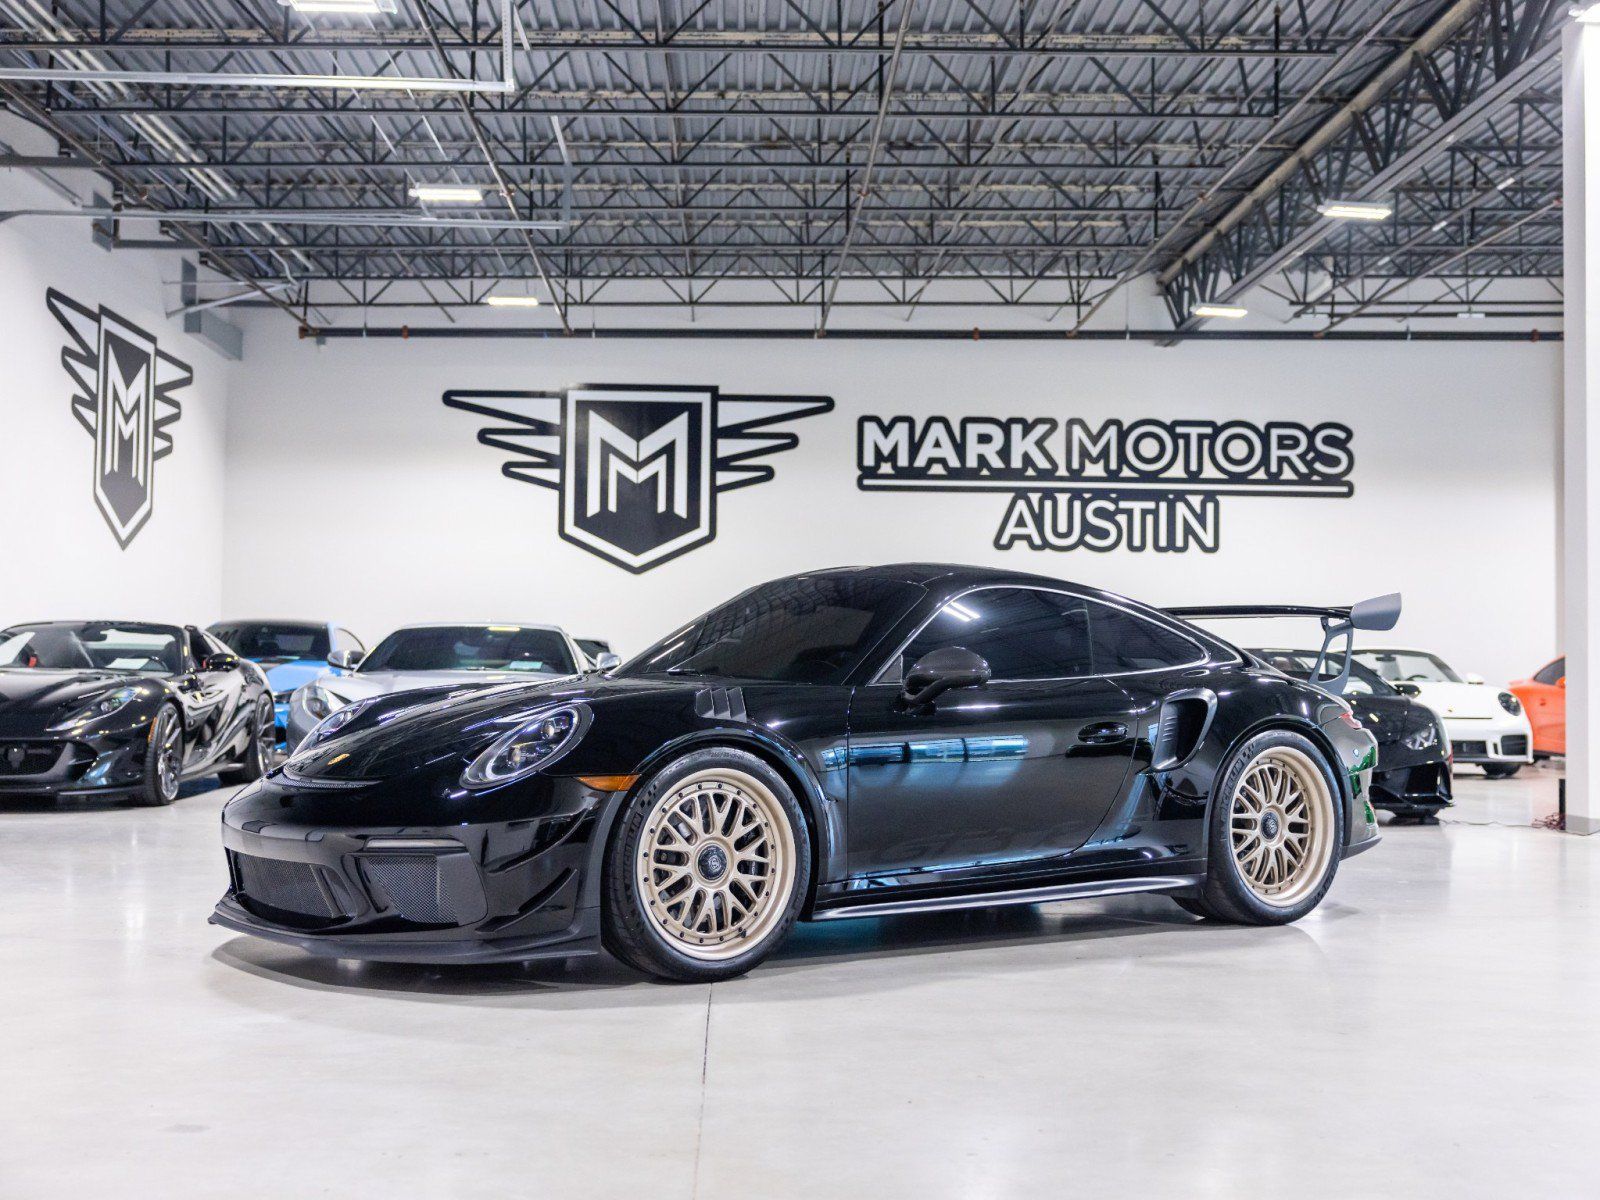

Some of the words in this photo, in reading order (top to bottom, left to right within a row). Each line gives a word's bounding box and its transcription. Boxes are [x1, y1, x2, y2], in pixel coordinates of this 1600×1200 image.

[858, 416, 1056, 474] MARK
[1067, 419, 1353, 477] MOTORS
[995, 492, 1219, 551] AUSTIN
